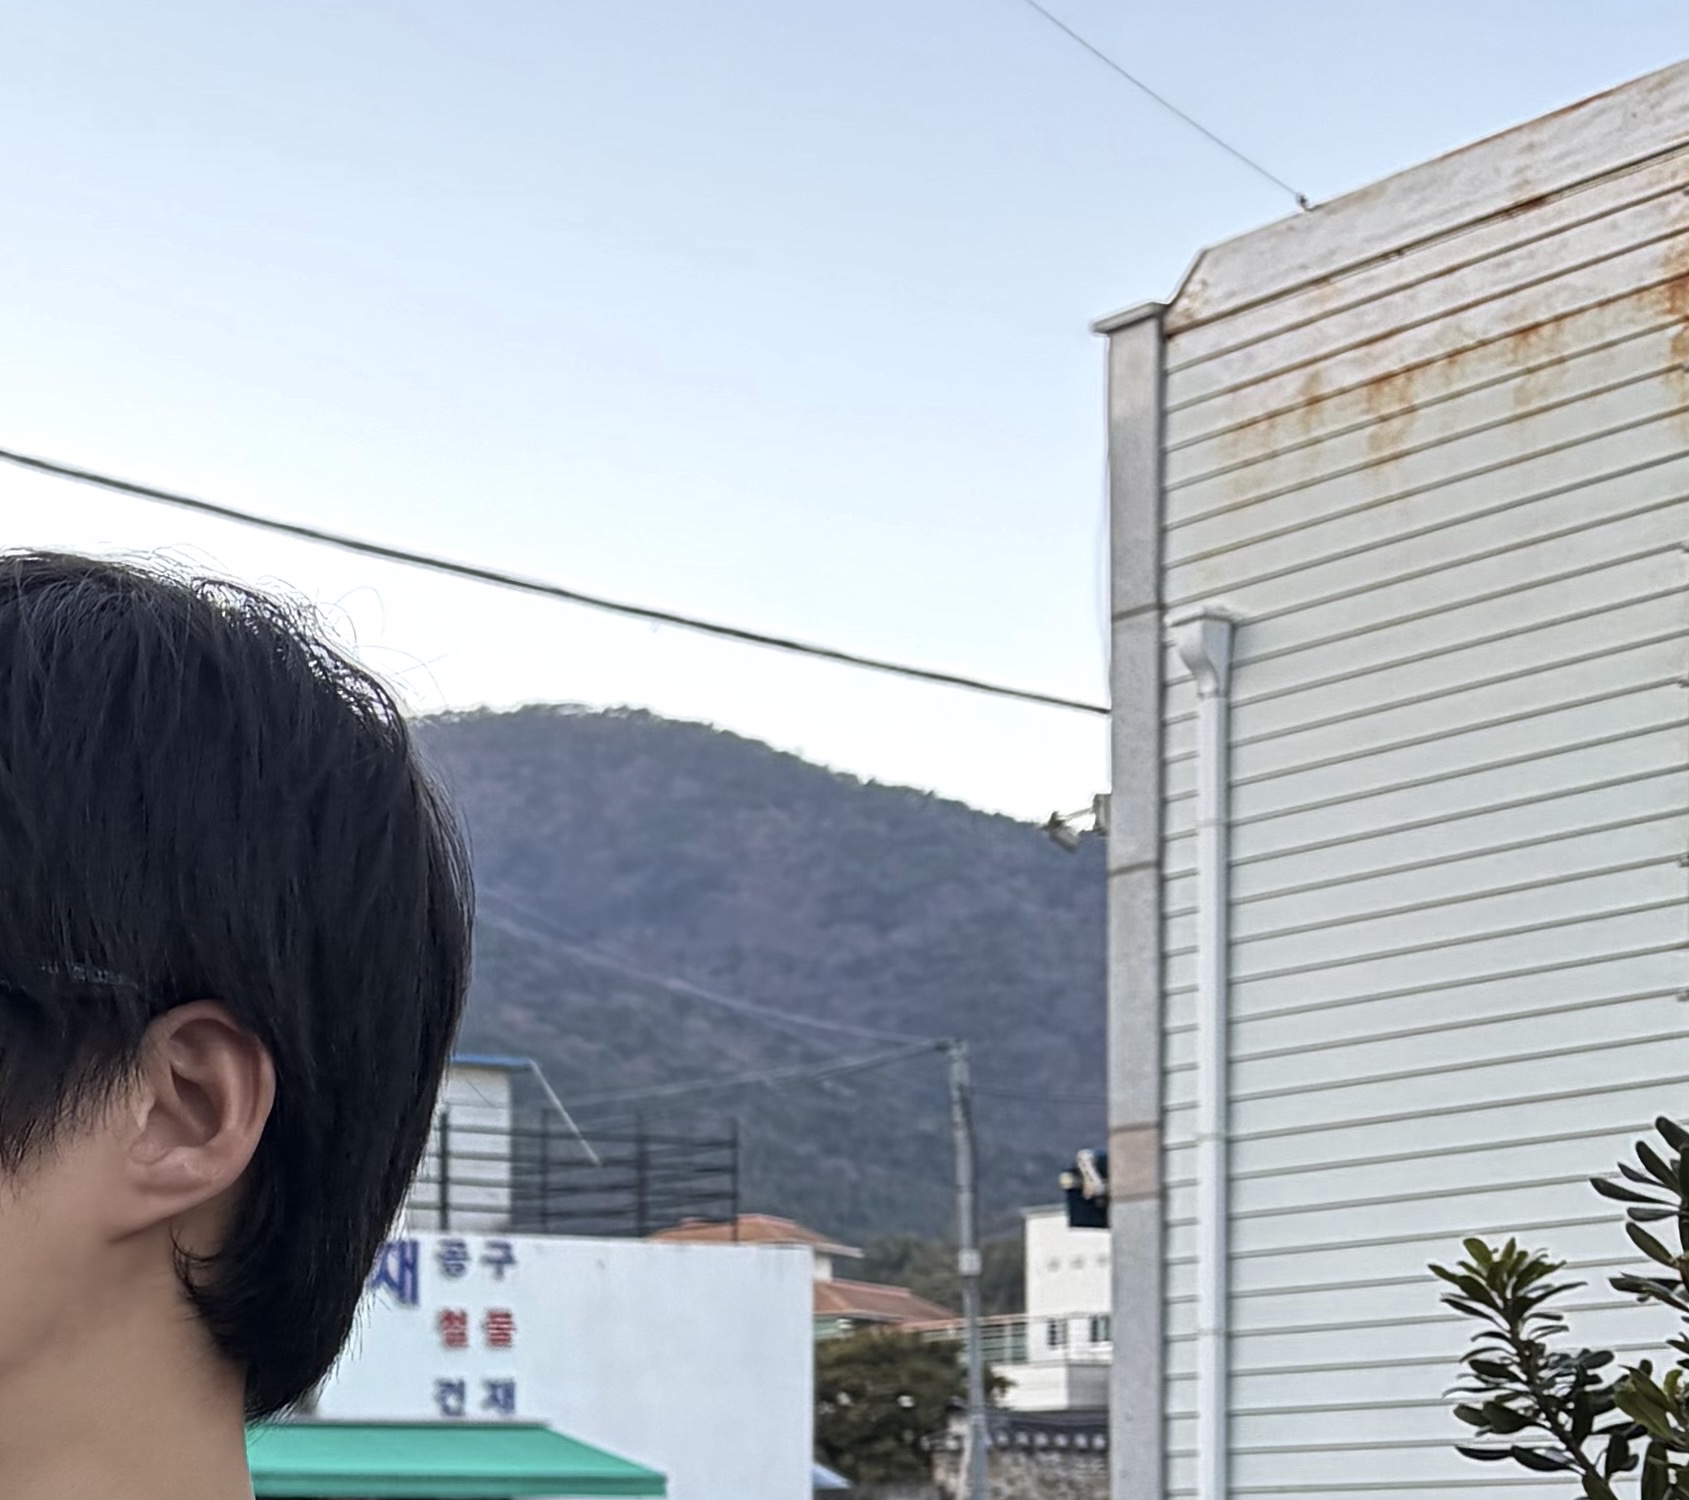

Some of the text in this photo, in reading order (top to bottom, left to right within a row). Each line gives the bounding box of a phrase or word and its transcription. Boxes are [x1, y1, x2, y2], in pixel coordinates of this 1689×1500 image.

[436, 1239, 516, 1280] 공구
[438, 1309, 516, 1349] 철물
[434, 1377, 516, 1417] 건재
